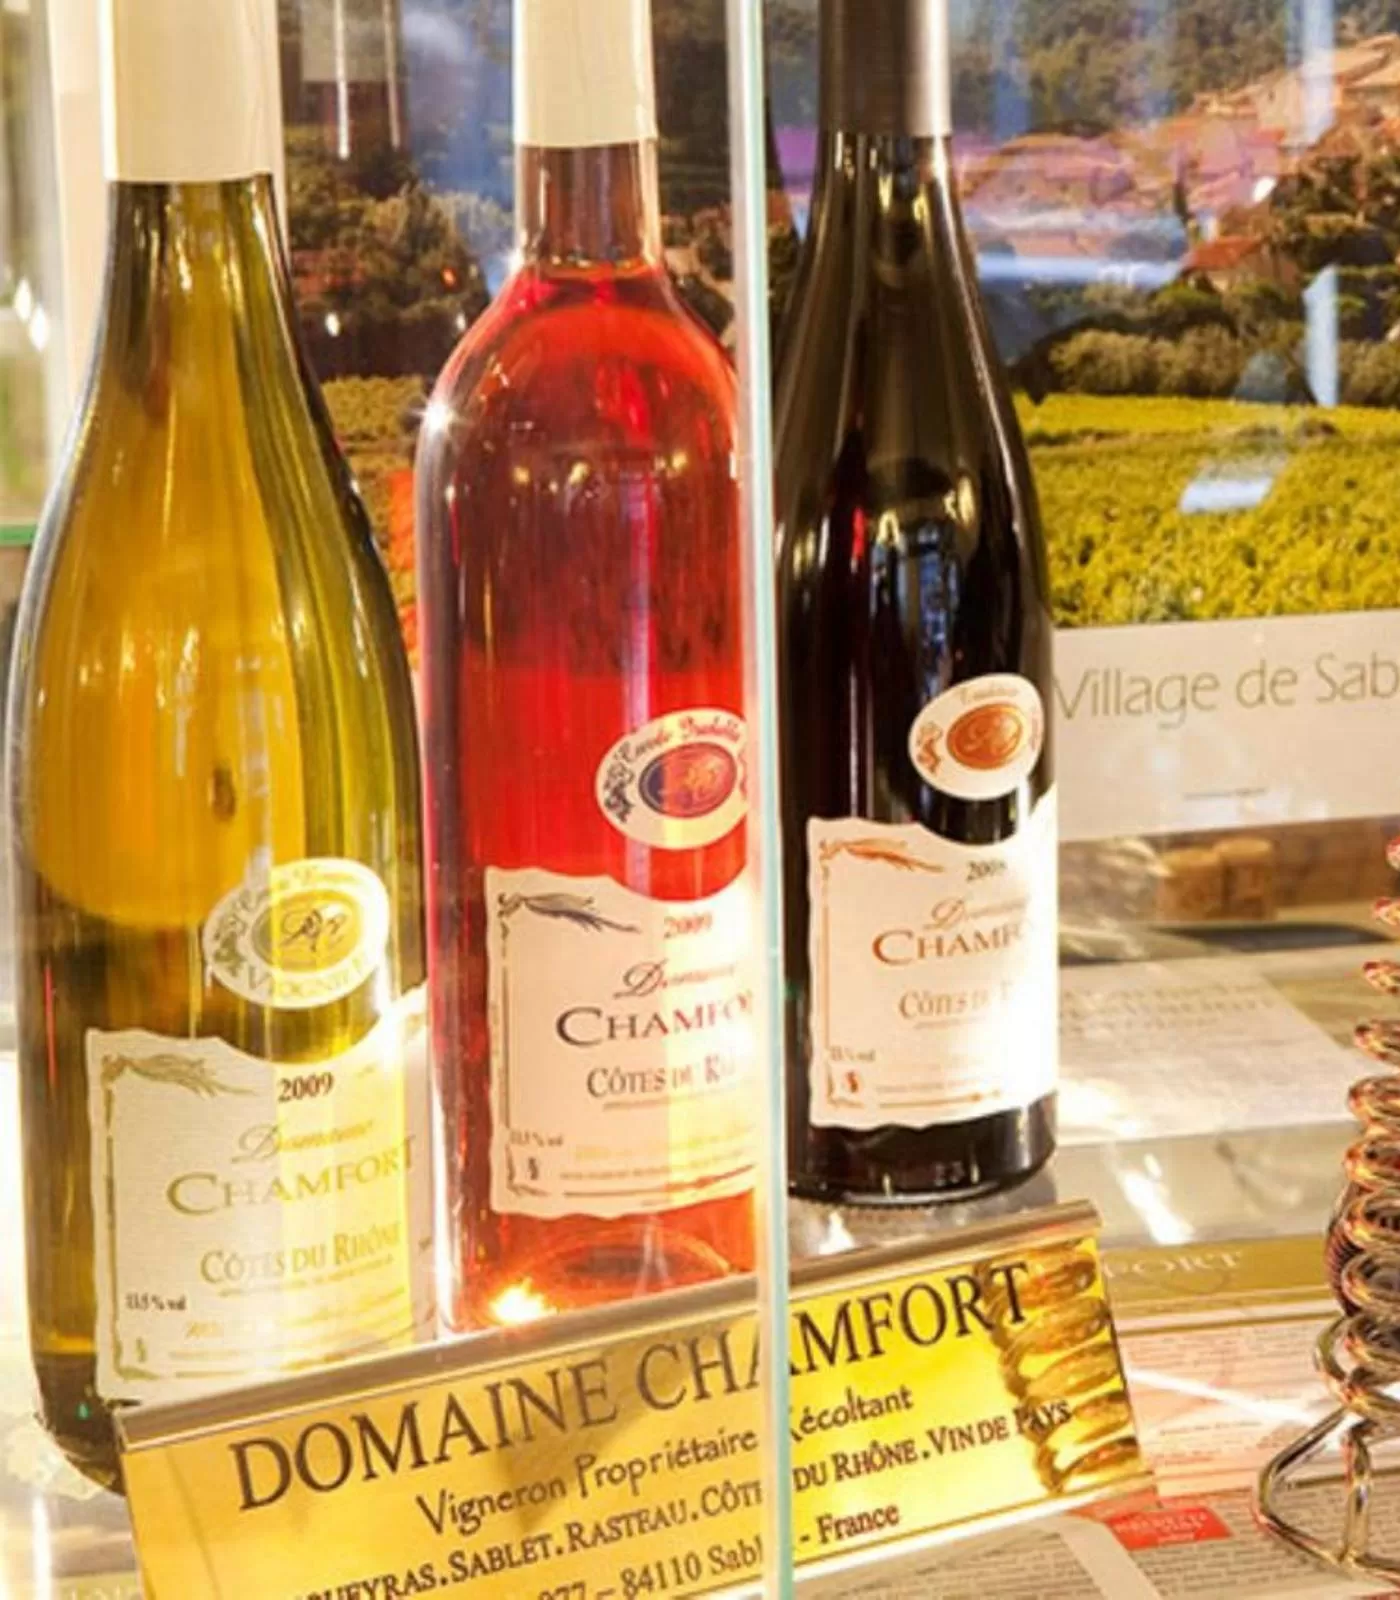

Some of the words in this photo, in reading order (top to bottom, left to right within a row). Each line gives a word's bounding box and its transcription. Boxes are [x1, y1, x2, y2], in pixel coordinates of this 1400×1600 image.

[1053, 667, 1220, 730] Village
[1235, 658, 1299, 709] de
[556, 989, 753, 1049] CHAMFO
[277, 1071, 335, 1103] 2009
[166, 1135, 416, 1217] CHAMFORT
[291, 1245, 327, 1275] DU
[228, 1354, 618, 1512] DOMAINE
[700, 1478, 764, 1518] CÔTE
[793, 1462, 828, 1493] DU
[926, 1422, 975, 1457] VIN
[978, 1415, 1009, 1446] DE
[1012, 1398, 1074, 1438] PAYS
[415, 1475, 567, 1537] Vigneron
[574, 1427, 760, 1499] Propriétaire
[620, 1551, 702, 1600] 84110
[707, 1533, 764, 1576] Sabl
[816, 1502, 902, 1546] France
